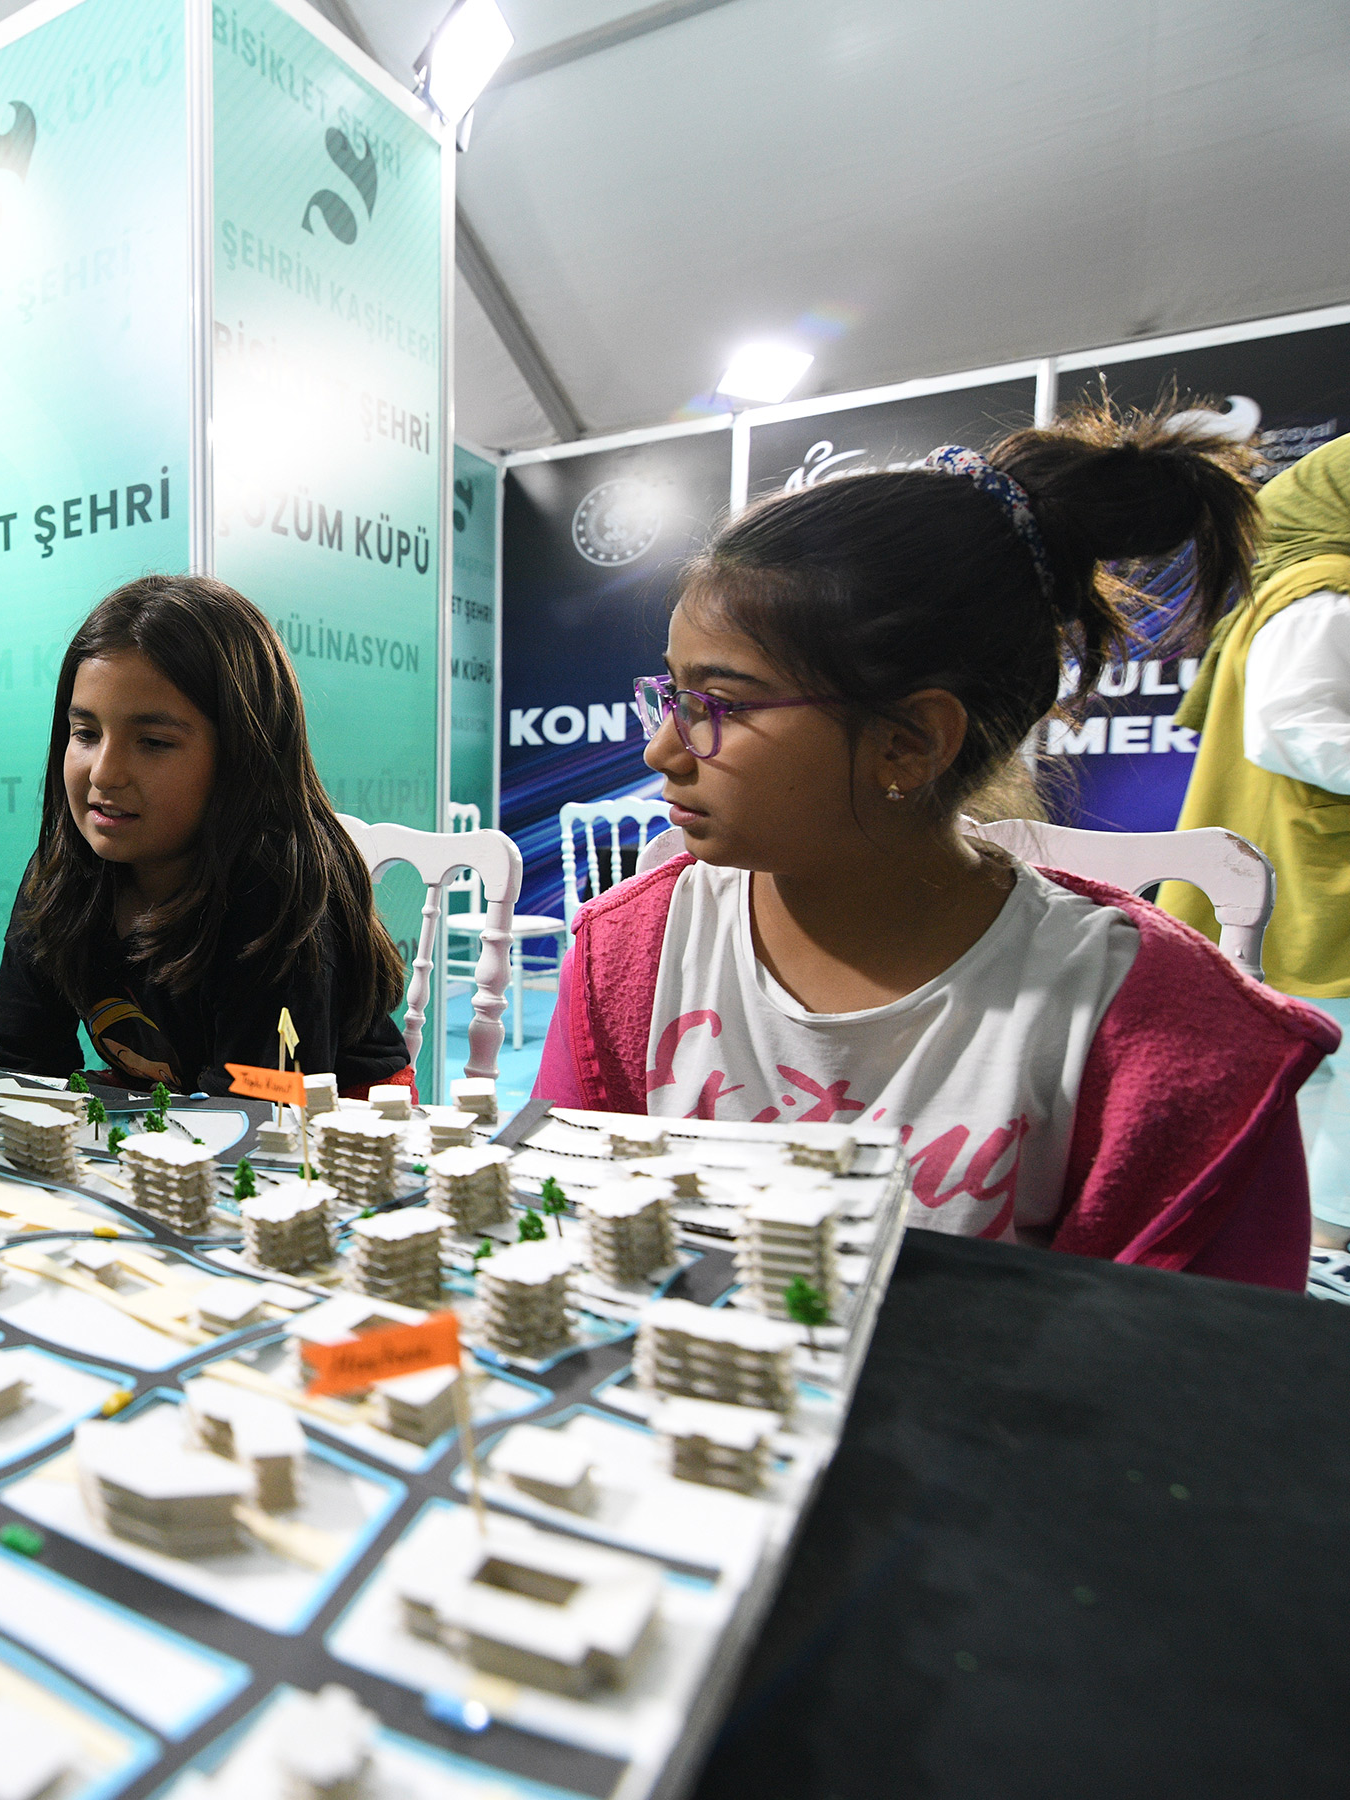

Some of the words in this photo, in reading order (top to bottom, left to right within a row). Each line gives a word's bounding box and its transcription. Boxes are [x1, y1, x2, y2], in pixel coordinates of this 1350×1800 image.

[212, 3, 327, 122] BİSİKLET
[220, 219, 322, 305] ŞEHRİN
[33, 465, 170, 559] ŞEHRİ
[354, 511, 431, 577] KÜPÜ
